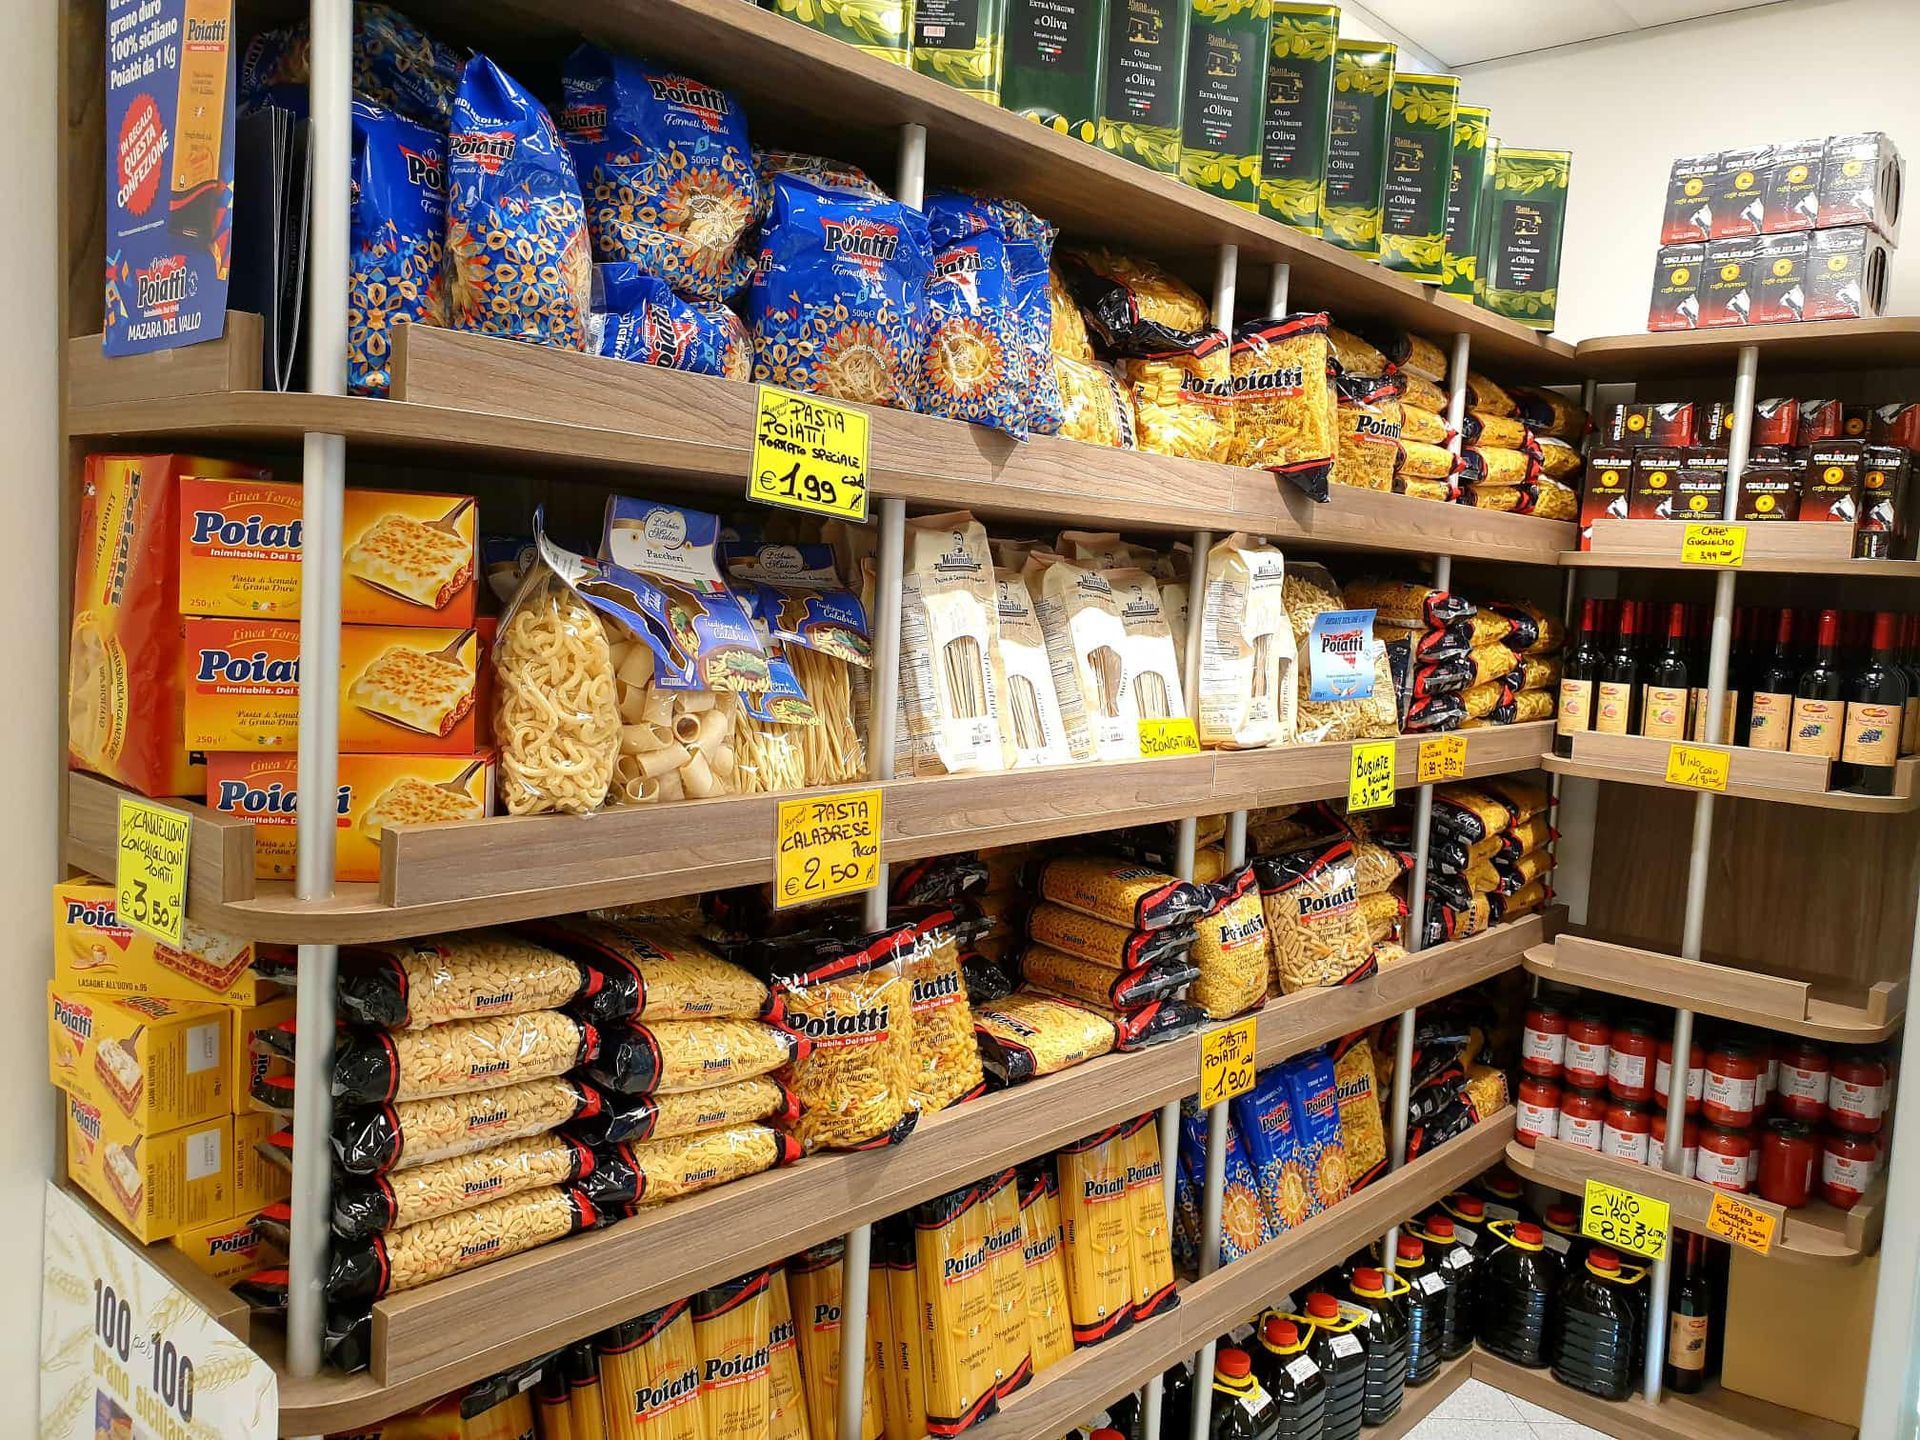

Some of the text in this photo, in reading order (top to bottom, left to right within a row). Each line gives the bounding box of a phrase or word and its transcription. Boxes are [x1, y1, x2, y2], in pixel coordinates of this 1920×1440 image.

[110, 0, 161, 42] grano duro
[187, 18, 226, 41] Poiatti
[1040, 15, 1068, 30] Oliva
[111, 18, 178, 62] 100% siciliano
[110, 43, 176, 90] Poiatti da 1 Kg
[1131, 74, 1156, 87] Oliva
[649, 78, 729, 115] Poiatti
[1209, 105, 1233, 117] Oliva
[121, 105, 153, 156] IN REGALO
[663, 113, 730, 136] Formati Speciali
[1272, 130, 1297, 141] Oliva
[124, 123, 156, 174] QUESTA
[449, 136, 516, 160] Poiatti
[117, 129, 169, 209] CONFEZIONE
[690, 155, 711, 167] 500g
[1332, 160, 1355, 170] Oliva
[1394, 195, 1416, 205] Oliva
[824, 225, 899, 260] Poiatti
[1515, 256, 1535, 266] Oliva
[136, 266, 188, 309] Poiatti
[852, 308, 870, 320] 500g
[127, 311, 201, 342] MAZARA DEL VALLO
[654, 302, 680, 368] oiatti
[789, 398, 845, 433] PASTA
[1355, 414, 1402, 440] Poiatti
[761, 410, 826, 446] POIATTI
[758, 433, 861, 469] FORMATO SPECIALE
[760, 462, 837, 505] € 1,99
[227, 490, 260, 504] Linea
[111, 470, 142, 608] Poiatti
[191, 510, 305, 547] Poiat
[210, 548, 290, 560] Inimitabile. Dal
[645, 549, 685, 563] Paccheri
[823, 609, 859, 627] Calabria
[232, 628, 266, 641] Linea
[713, 627, 749, 641] Calabria
[1321, 636, 1364, 653] Poiatti
[216, 686, 295, 696] Inimitabile. Dal
[1356, 754, 1389, 778] BUSIATE
[812, 800, 869, 823] PASTA
[133, 811, 185, 843] CANNELLONI
[781, 821, 872, 853] CALABRESE
[121, 836, 184, 866] CONCHIGLIONI
[784, 856, 860, 896] € 2,50
[121, 890, 131, 913] €
[1298, 883, 1357, 915] Poiatti
[1219, 914, 1265, 943] Poiatti
[77, 977, 105, 989] LASAGNE
[105, 979, 133, 991] ALL'UOVO
[911, 970, 959, 1002] iatti
[475, 992, 514, 1007] Poiatti
[683, 1002, 714, 1013] Poiatti
[53, 1001, 93, 1039] Poiatti
[788, 1005, 889, 1038] Poiatti
[1218, 1030, 1248, 1049] PASTA
[470, 1059, 511, 1076] Poiatti
[702, 1056, 731, 1070] Poiatti
[1204, 1046, 1241, 1069] POIATTI
[1336, 1074, 1370, 1099] oiatti
[70, 1101, 101, 1140] Poiatti
[469, 1109, 508, 1127] Poiatti
[697, 1110, 727, 1124] Poiatti
[463, 1175, 503, 1194] Poiatti
[684, 1166, 718, 1183] Poiatti
[1605, 1192, 1640, 1214] VINO
[1729, 1200, 1765, 1223] POLPA di
[460, 1237, 500, 1257] Poiatti
[94, 1278, 131, 1363] 100
[93, 1342, 130, 1402] grano
[704, 1345, 770, 1382] Poiatti
[151, 1331, 194, 1424] 100
[634, 1364, 700, 1413] Poiatti
